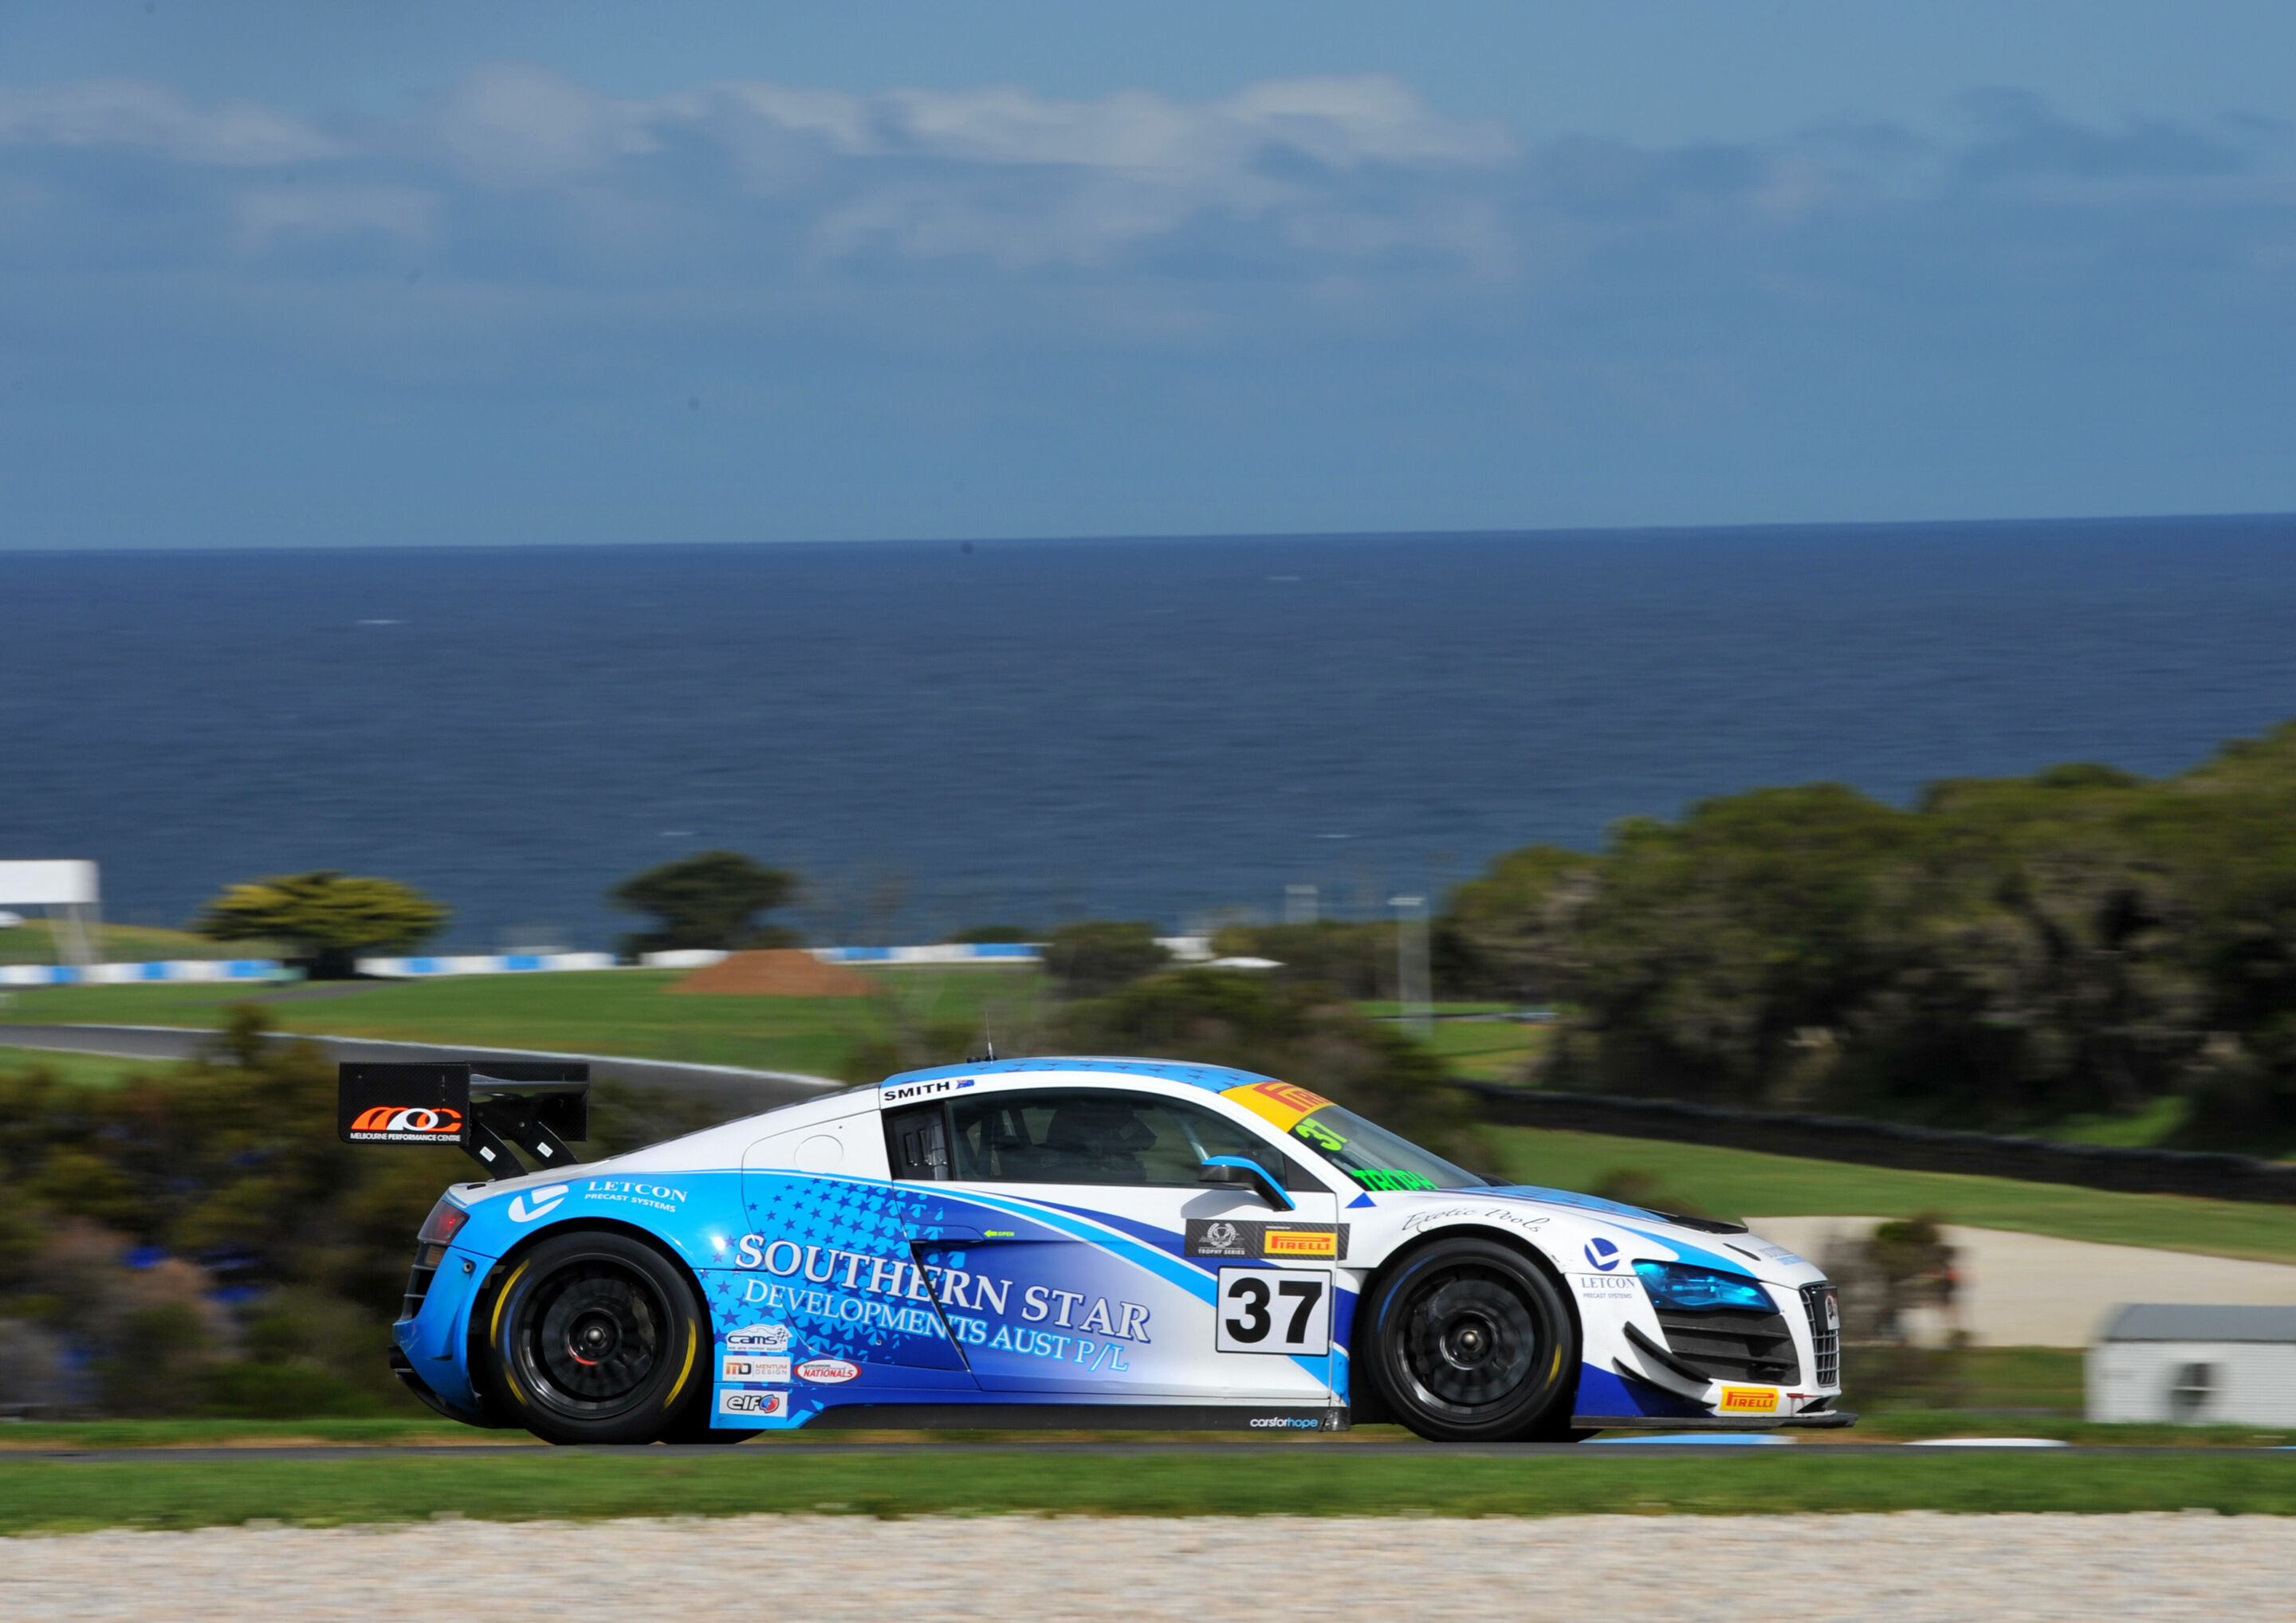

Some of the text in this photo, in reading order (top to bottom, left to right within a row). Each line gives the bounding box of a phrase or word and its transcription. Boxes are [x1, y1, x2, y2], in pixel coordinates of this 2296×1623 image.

[884, 1081, 949, 1101] SMITH
[1295, 1118, 1348, 1151] 37
[588, 1181, 688, 1203] LETCON
[631, 1197, 676, 1212] SYSTEMS
[1402, 1208, 1551, 1233] Exotic Pools
[1272, 1236, 1331, 1250] PIRELLI
[735, 1234, 1151, 1342] SOUTHERN STAR
[1581, 1277, 1635, 1288] LETCON
[1225, 1277, 1323, 1344] 37
[745, 1278, 1129, 1371] DEVELOPMENTS AUST P/L
[728, 1335, 777, 1345] cams
[804, 1369, 854, 1377] NATIONALS
[727, 1396, 761, 1410] elf
[1726, 1392, 1775, 1408] PIRELLI
[1250, 1417, 1319, 1428] carsforhope
